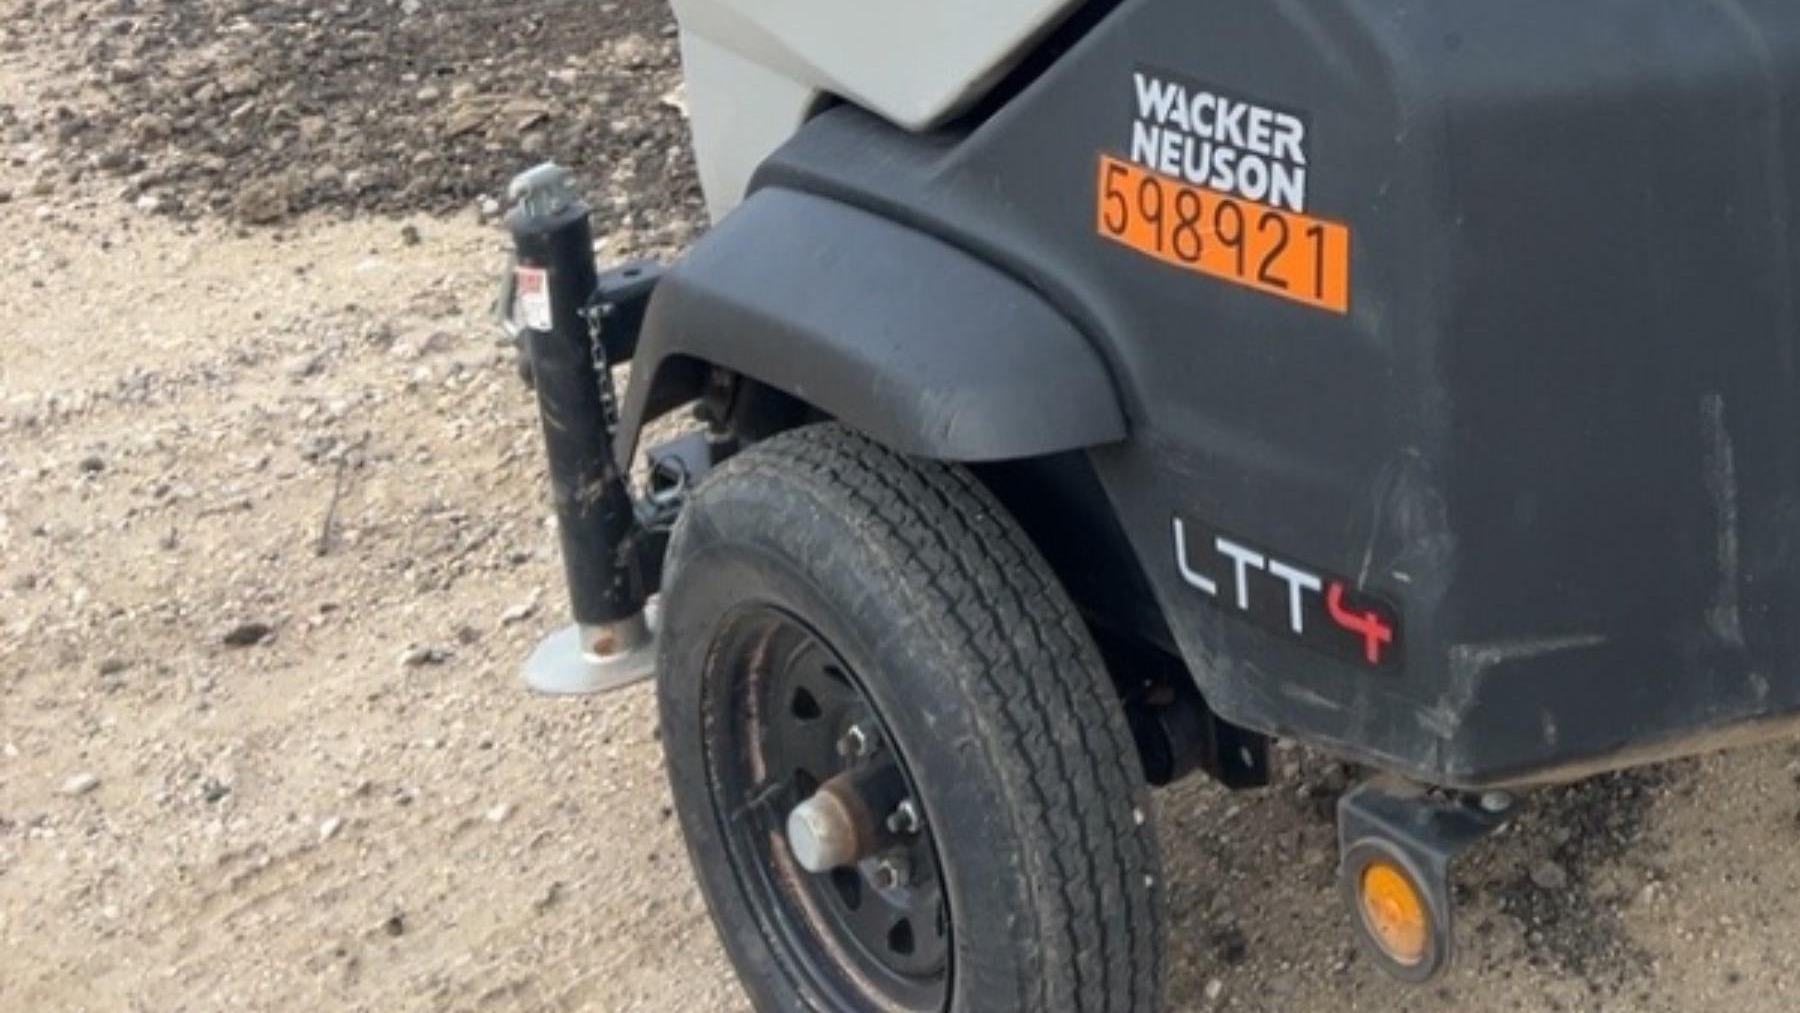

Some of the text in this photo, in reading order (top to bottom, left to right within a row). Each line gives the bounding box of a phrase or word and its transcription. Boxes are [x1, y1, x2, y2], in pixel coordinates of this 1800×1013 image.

[1130, 120, 1307, 213] NEUSON
[1132, 72, 1307, 165] WACKER
[1103, 163, 1325, 300] 598921
[1173, 517, 1393, 664] LTT4
